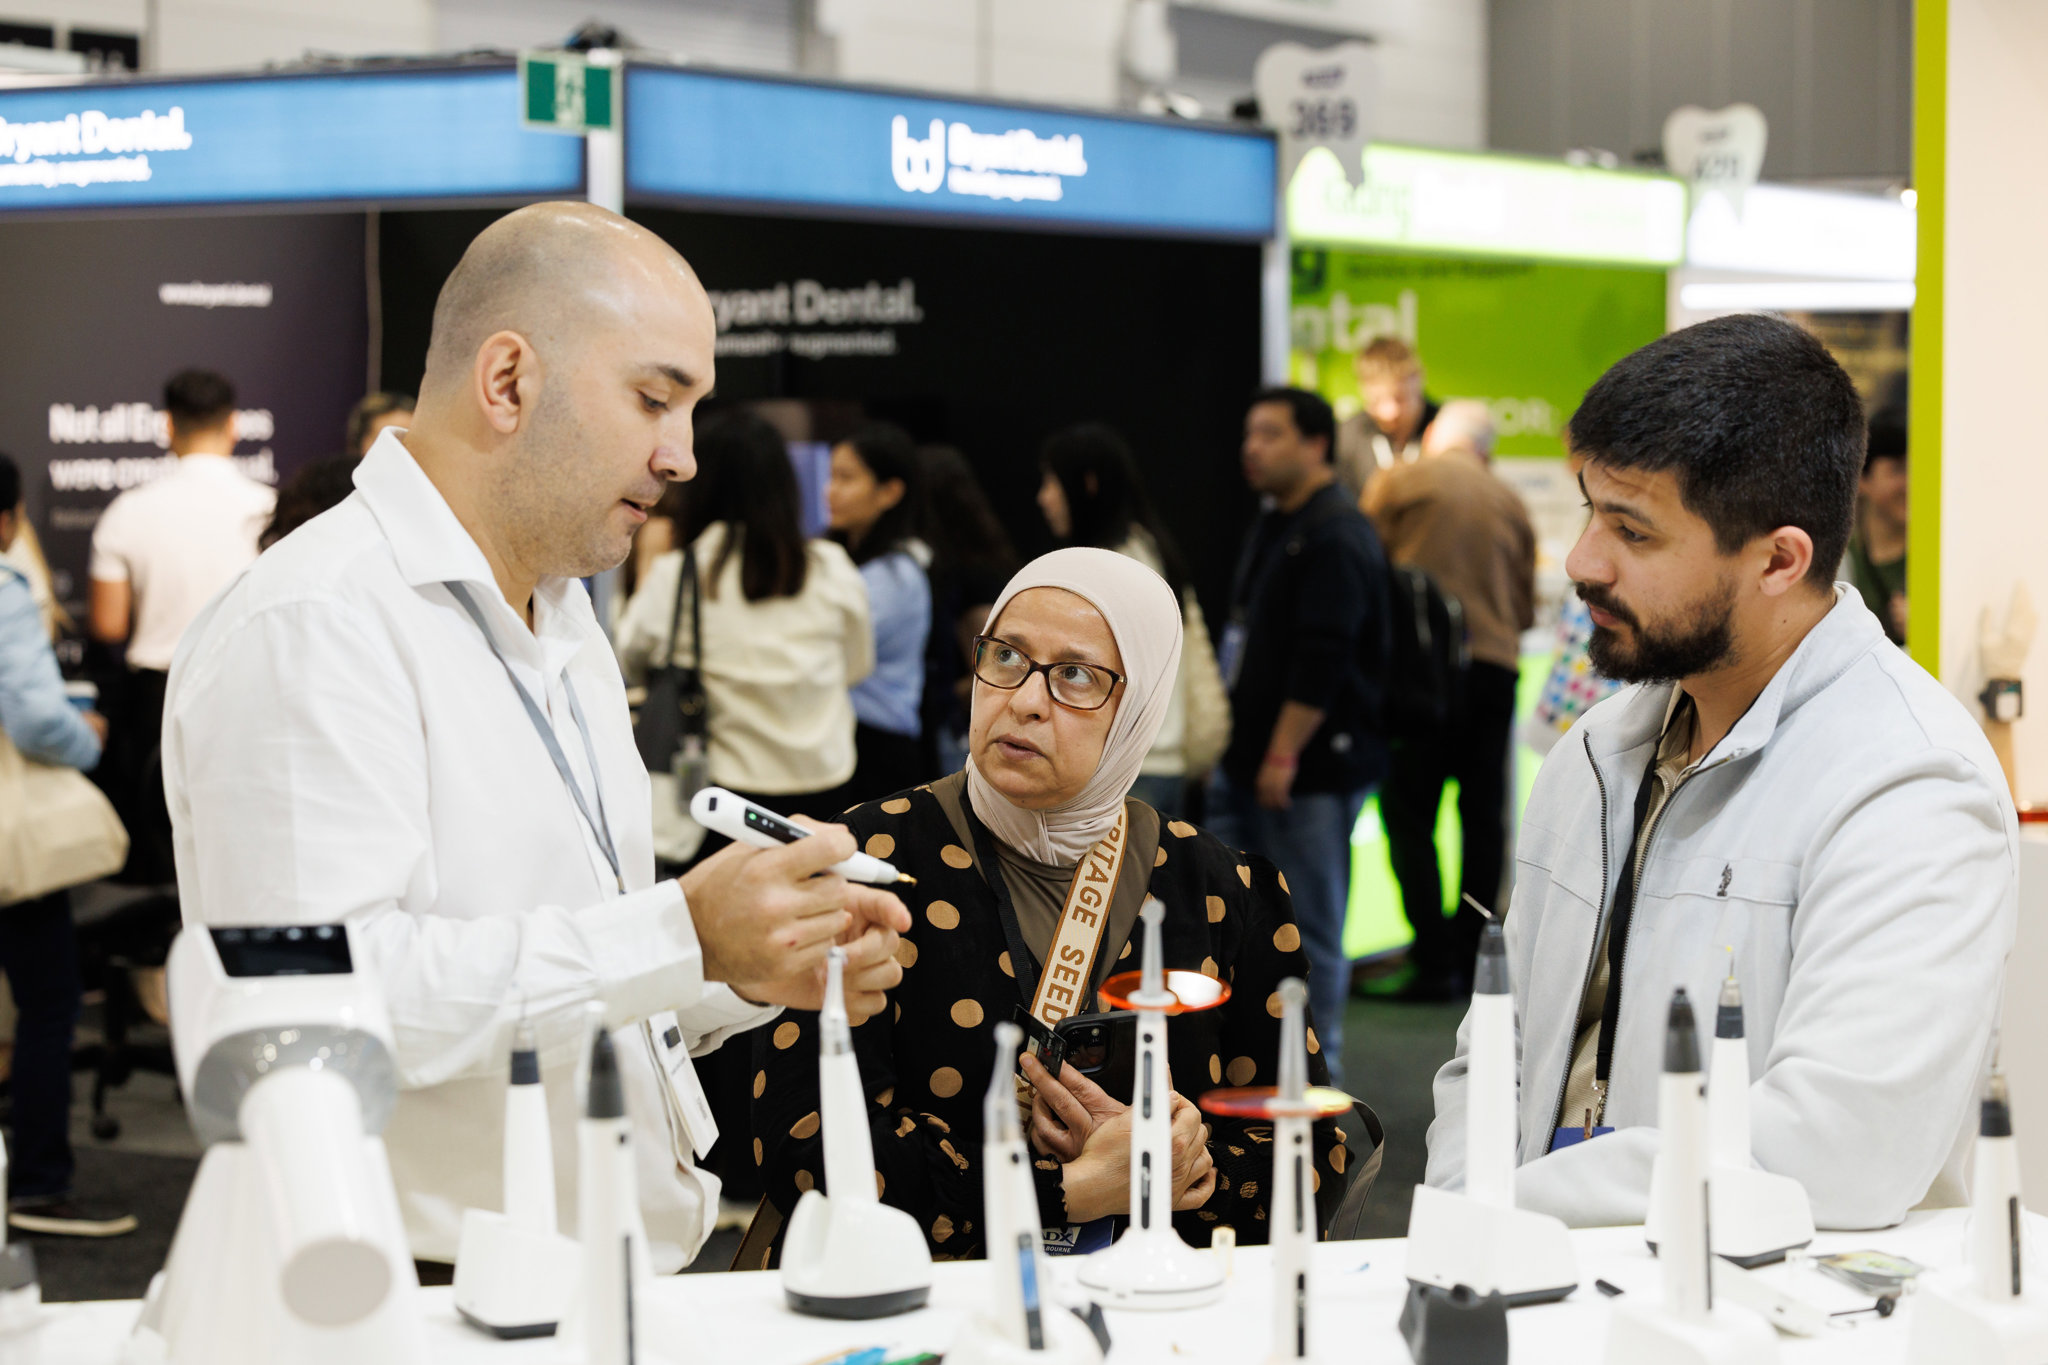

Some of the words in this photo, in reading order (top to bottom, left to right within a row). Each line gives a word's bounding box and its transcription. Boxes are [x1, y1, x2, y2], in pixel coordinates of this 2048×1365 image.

[0, 113, 82, 165] ryant
[792, 277, 924, 325] Dental.
[1072, 814, 1122, 929] RITAGE
[1042, 1231, 1074, 1245] DX
